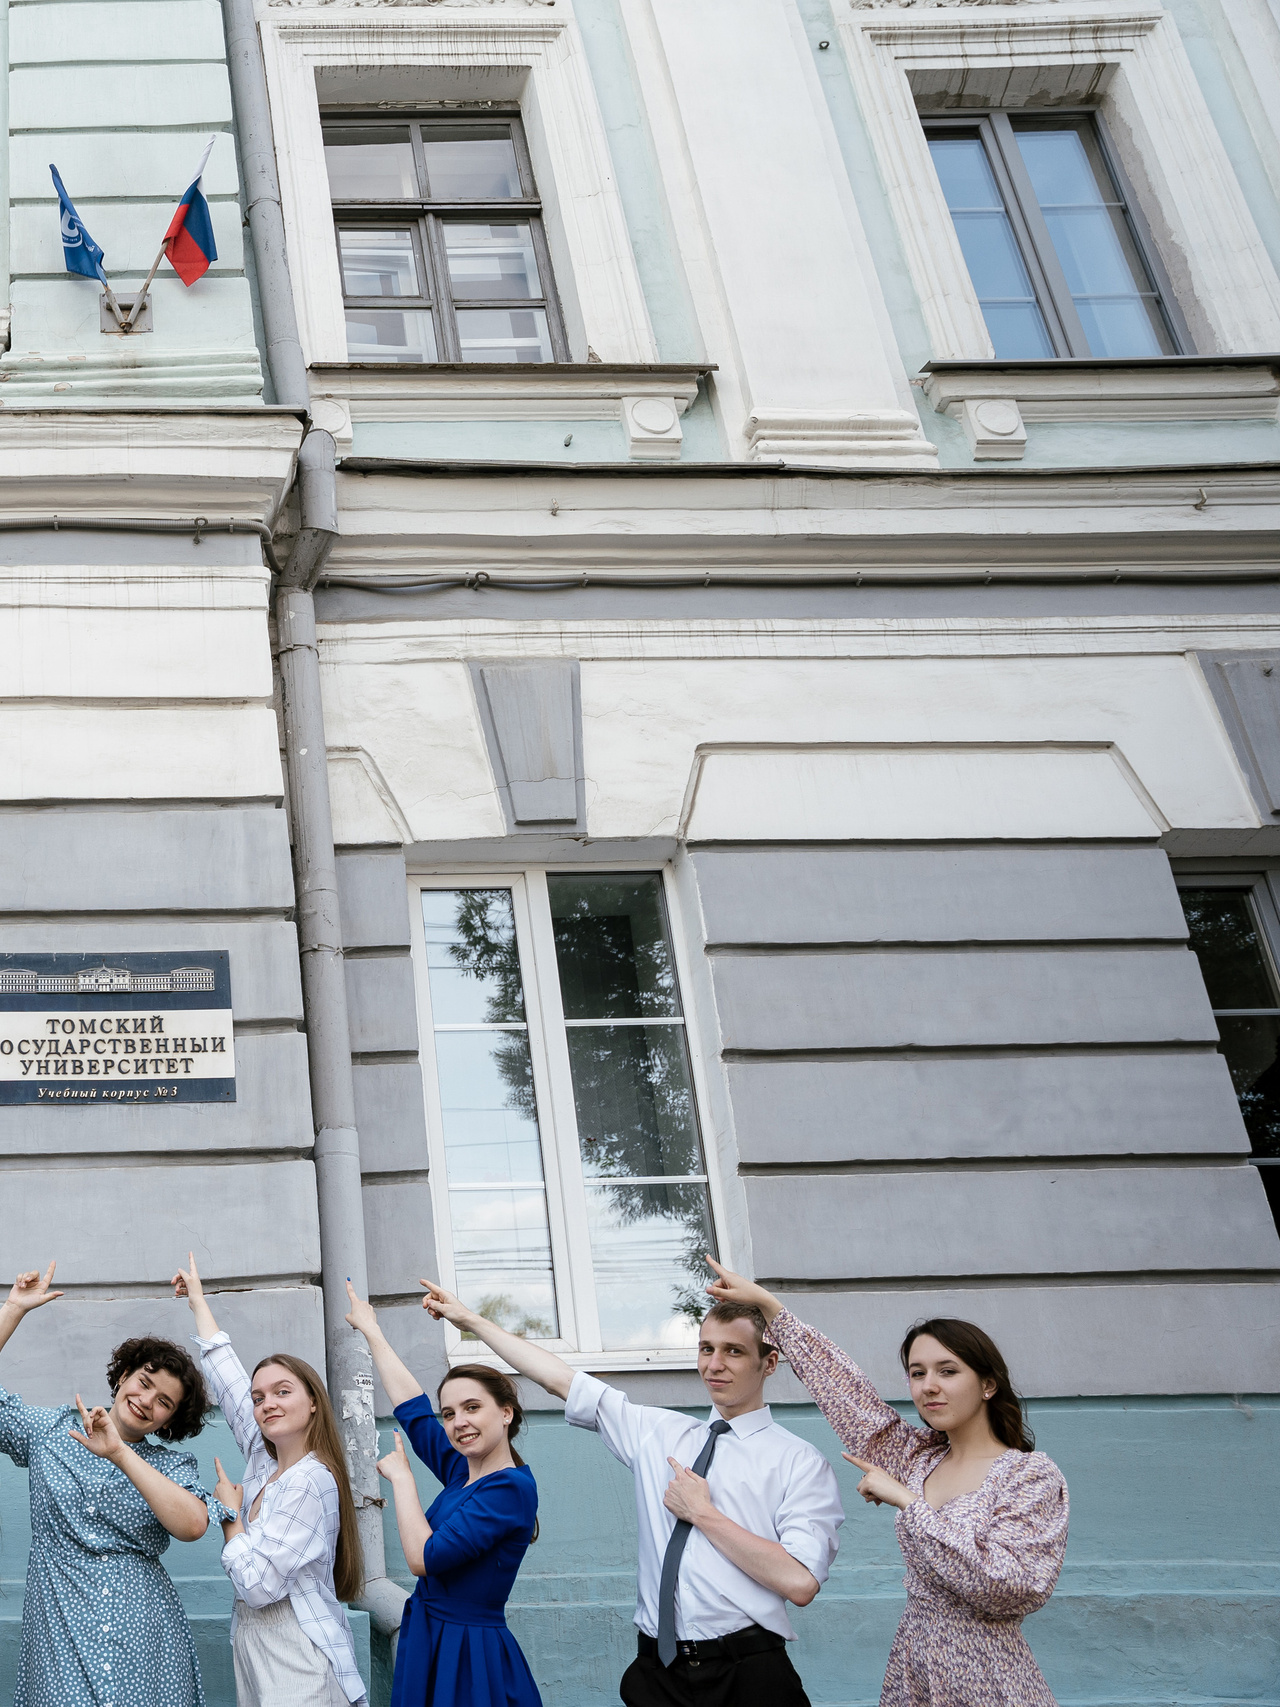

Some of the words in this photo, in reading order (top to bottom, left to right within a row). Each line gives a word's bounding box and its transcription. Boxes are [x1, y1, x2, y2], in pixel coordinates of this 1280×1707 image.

[46, 1015, 164, 1034] ТОМСКИЙ
[20, 1058, 195, 1076] УНИВЕРСИТЕТ
[38, 1088, 97, 1098] Учебный
[102, 1089, 150, 1100] корпус
[154, 1086, 168, 1097] №
[170, 1086, 178, 1096] 3
